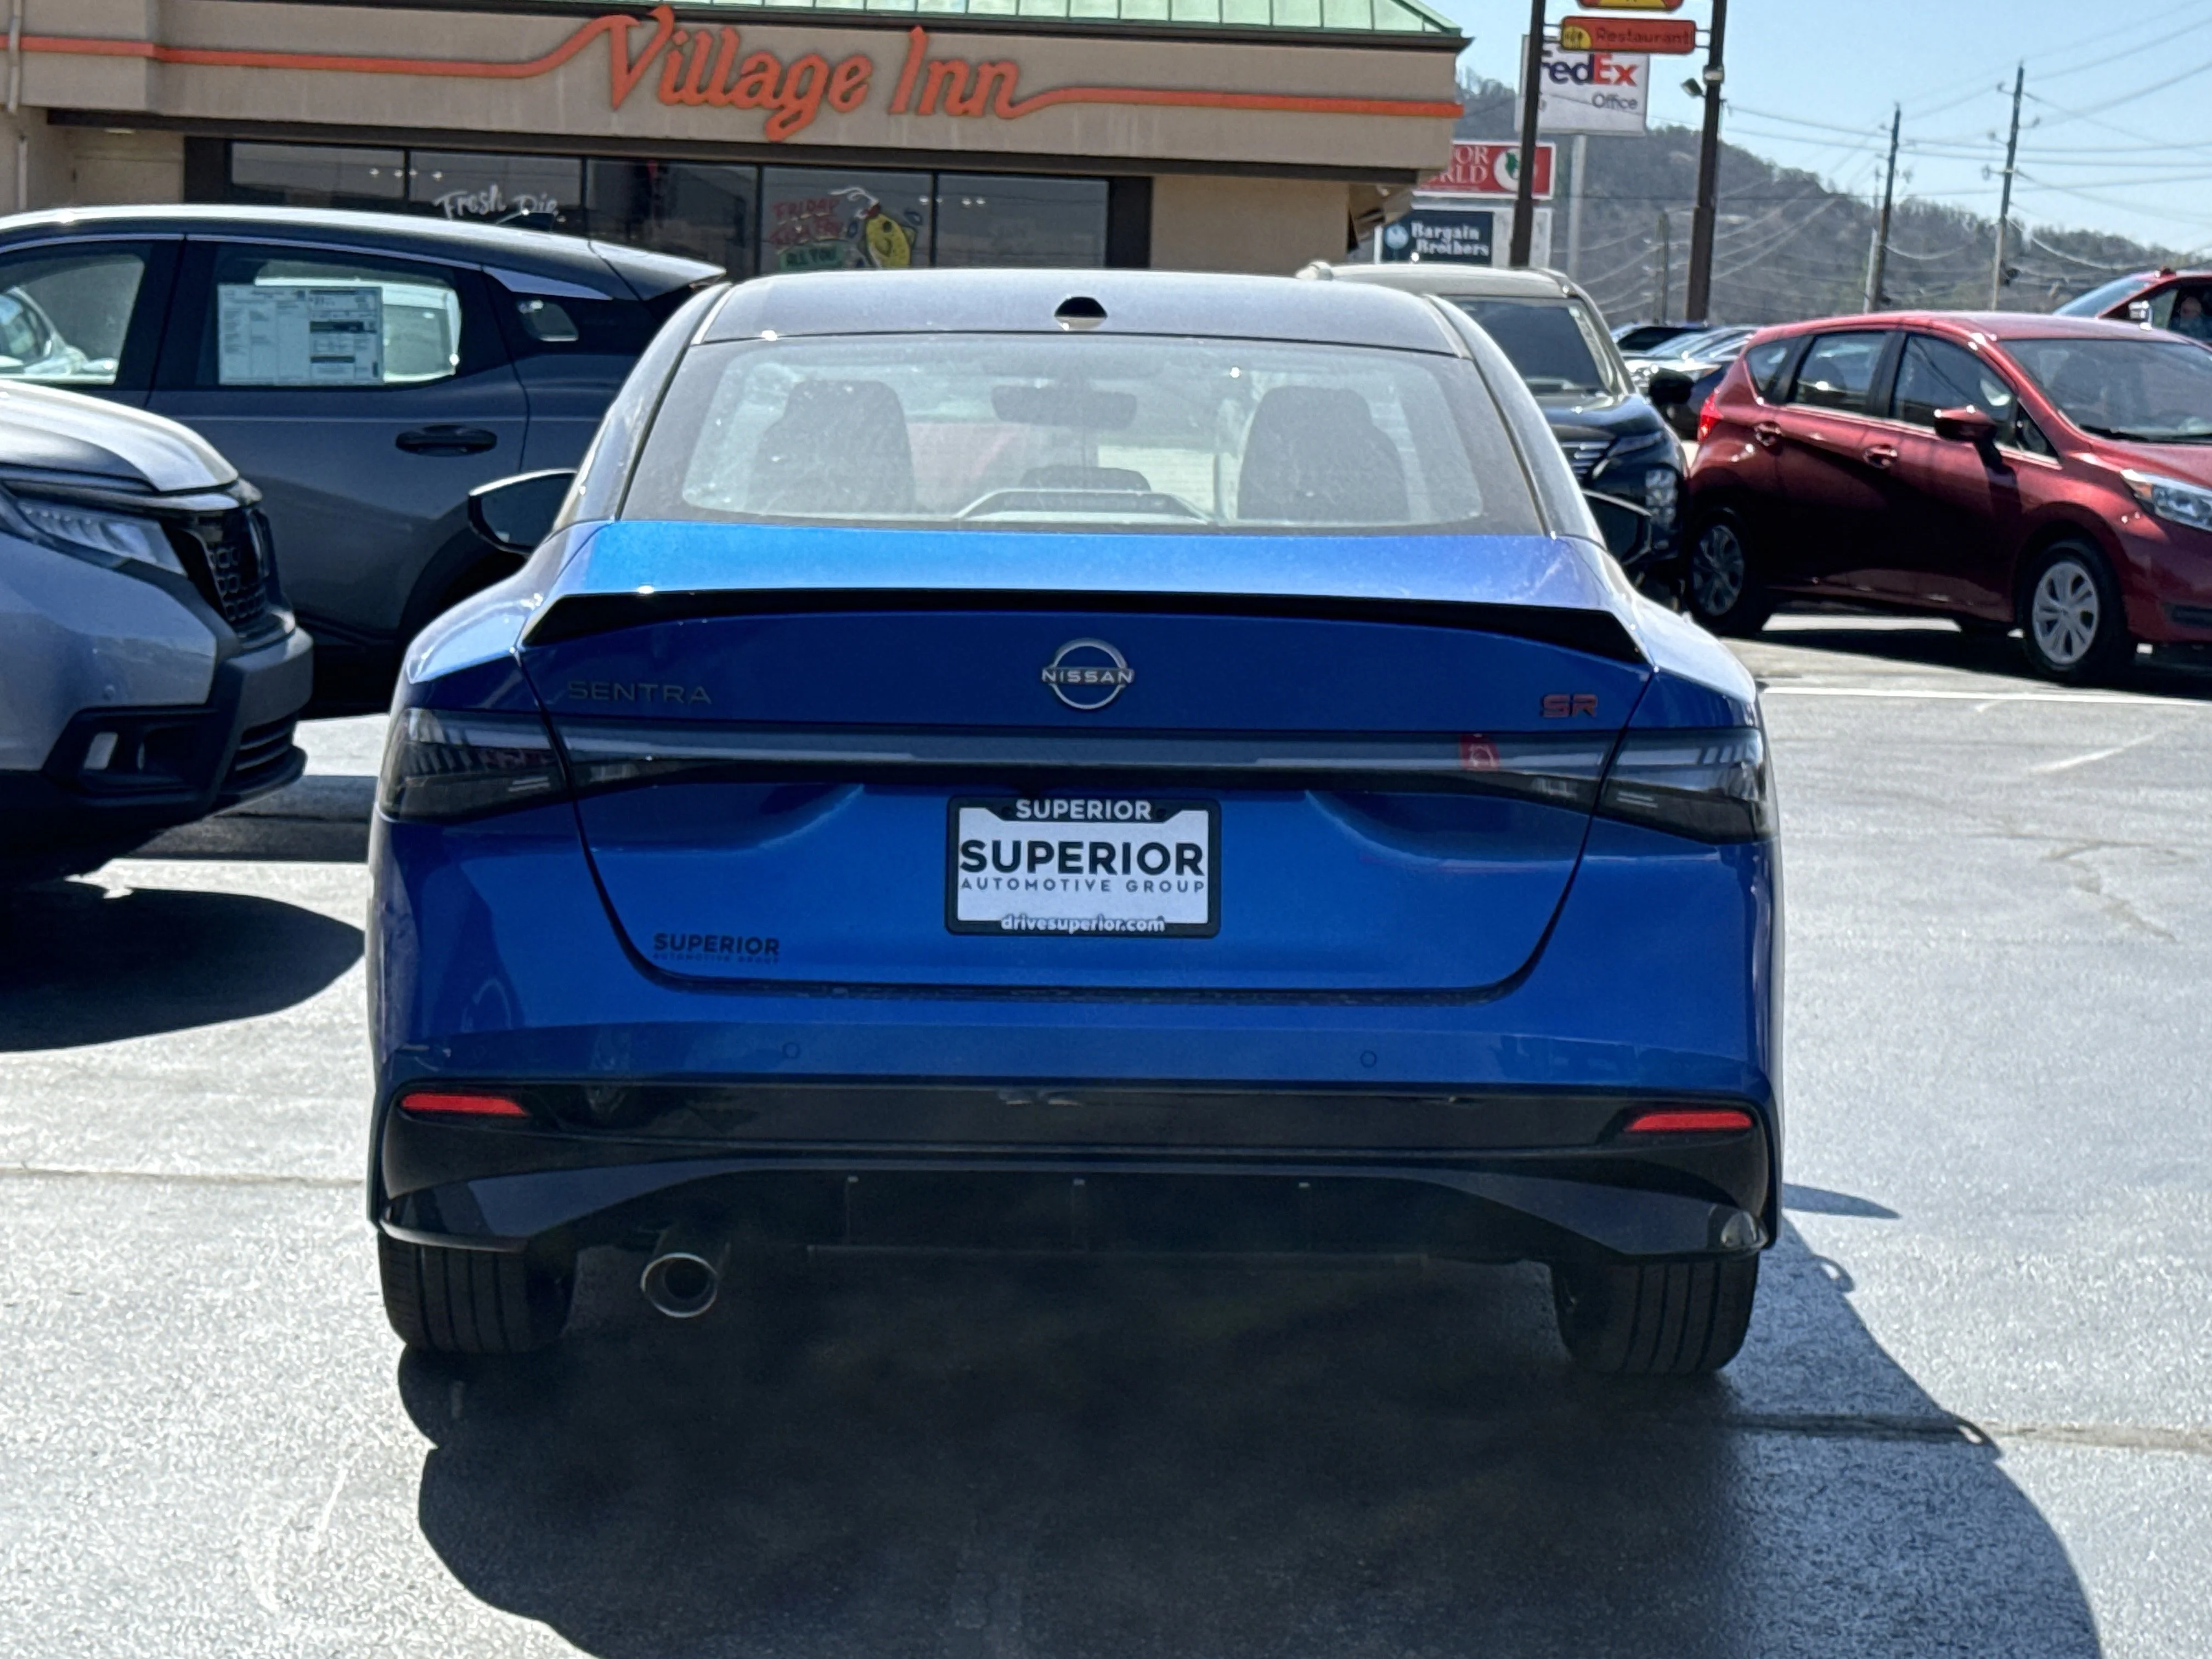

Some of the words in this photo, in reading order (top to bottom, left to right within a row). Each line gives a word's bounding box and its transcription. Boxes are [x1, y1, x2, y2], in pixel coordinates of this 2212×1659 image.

[1596, 26, 1690, 45] Restaurant
[594, 4, 873, 142] Village
[887, 25, 1028, 120] Inn
[1592, 92, 1639, 110] Office
[432, 184, 507, 221] Fresh
[1410, 220, 1480, 242] Bargain
[1416, 238, 1490, 257] Brothers
[1041, 669, 1133, 684] NISSAN
[567, 680, 712, 705] SENTRA
[1542, 693, 1598, 718] SR
[1015, 799, 1152, 821] SUPERIOR
[960, 839, 1205, 876] SUPERIOR
[961, 877, 1112, 892] AUTOMOTIVE
[1125, 879, 1205, 893] GROUP
[1000, 914, 1166, 935] drivesuperior.com
[653, 933, 780, 956] SUPERIOR
